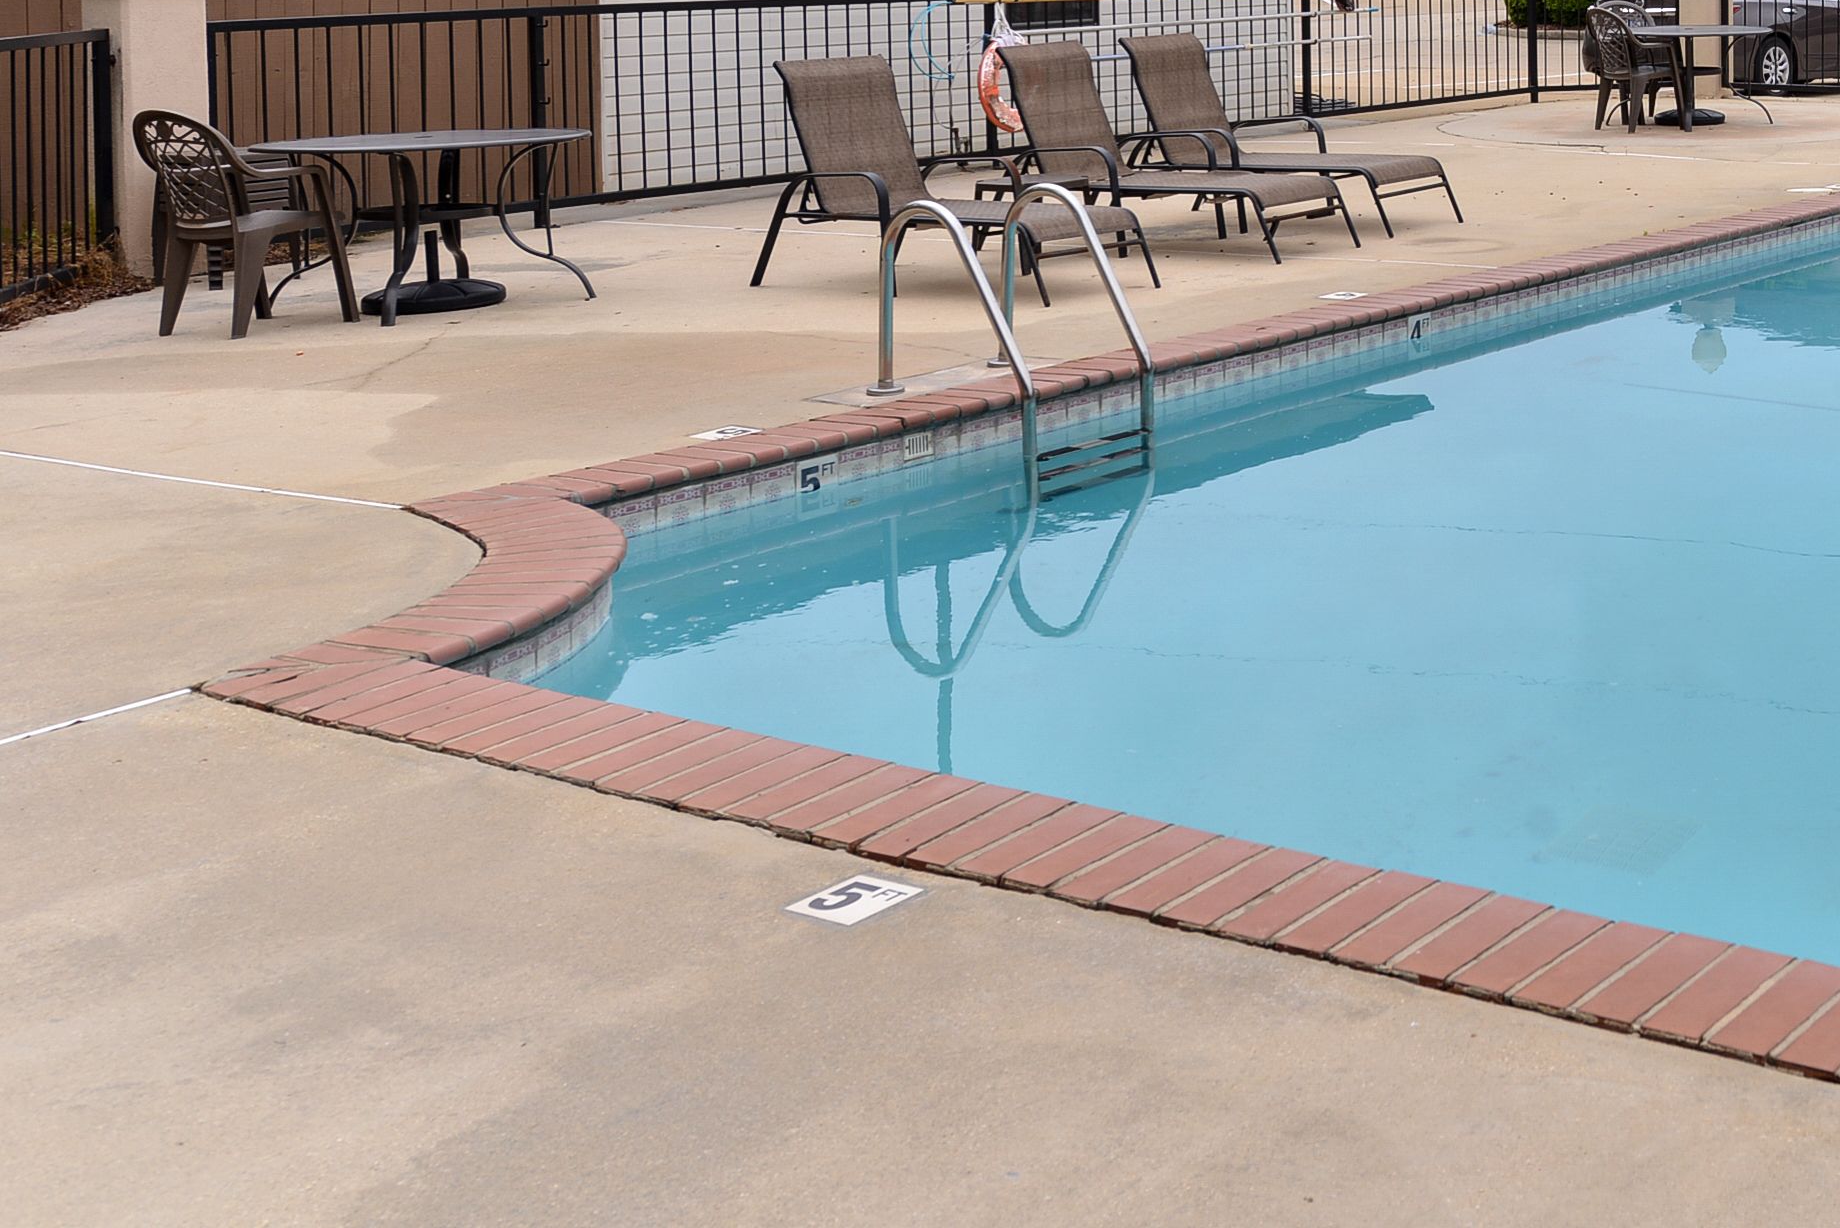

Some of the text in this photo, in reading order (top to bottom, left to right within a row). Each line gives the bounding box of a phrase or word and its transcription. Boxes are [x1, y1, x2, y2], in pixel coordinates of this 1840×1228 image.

[1422, 317, 1430, 328] FT
[801, 461, 836, 494] 5 FT
[808, 881, 908, 911] 5 FT
